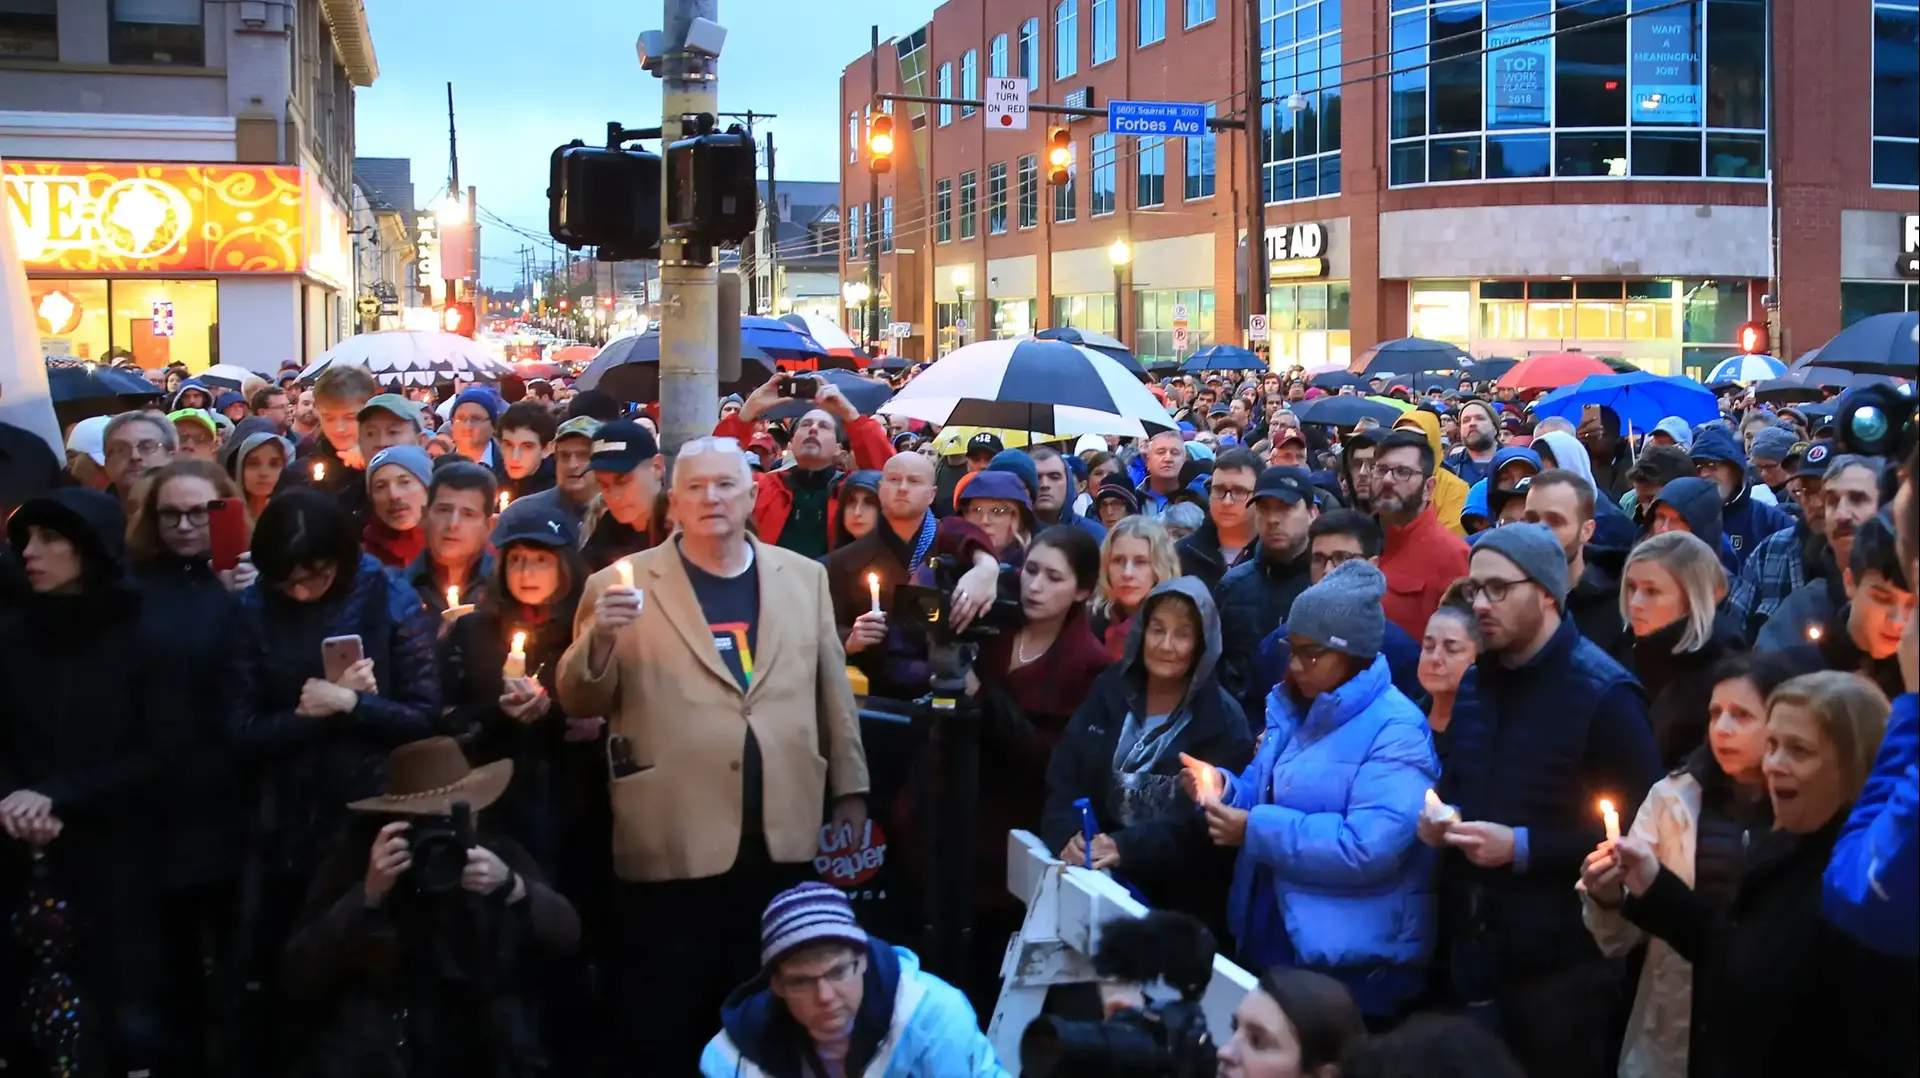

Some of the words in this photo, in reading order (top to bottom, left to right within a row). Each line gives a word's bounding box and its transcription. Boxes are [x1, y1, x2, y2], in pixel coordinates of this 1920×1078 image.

[1651, 24, 1682, 34] WANT
[1662, 39, 1671, 48] A
[1634, 52, 1699, 62] MEANINGFUL
[1503, 57, 1537, 71] TOP
[1504, 71, 1537, 83] WORK
[1001, 80, 1015, 90] NO
[1503, 81, 1537, 92] PLACES
[996, 92, 1019, 101] TURN
[1508, 94, 1532, 104] 2018
[988, 104, 1000, 112] ON
[1007, 104, 1025, 113] RED
[1138, 106, 1165, 116] Squirrel
[1166, 107, 1178, 115] Hill
[1116, 117, 1167, 131] Forbes
[1173, 119, 1199, 132] Ave
[1290, 223, 1321, 258] AID
